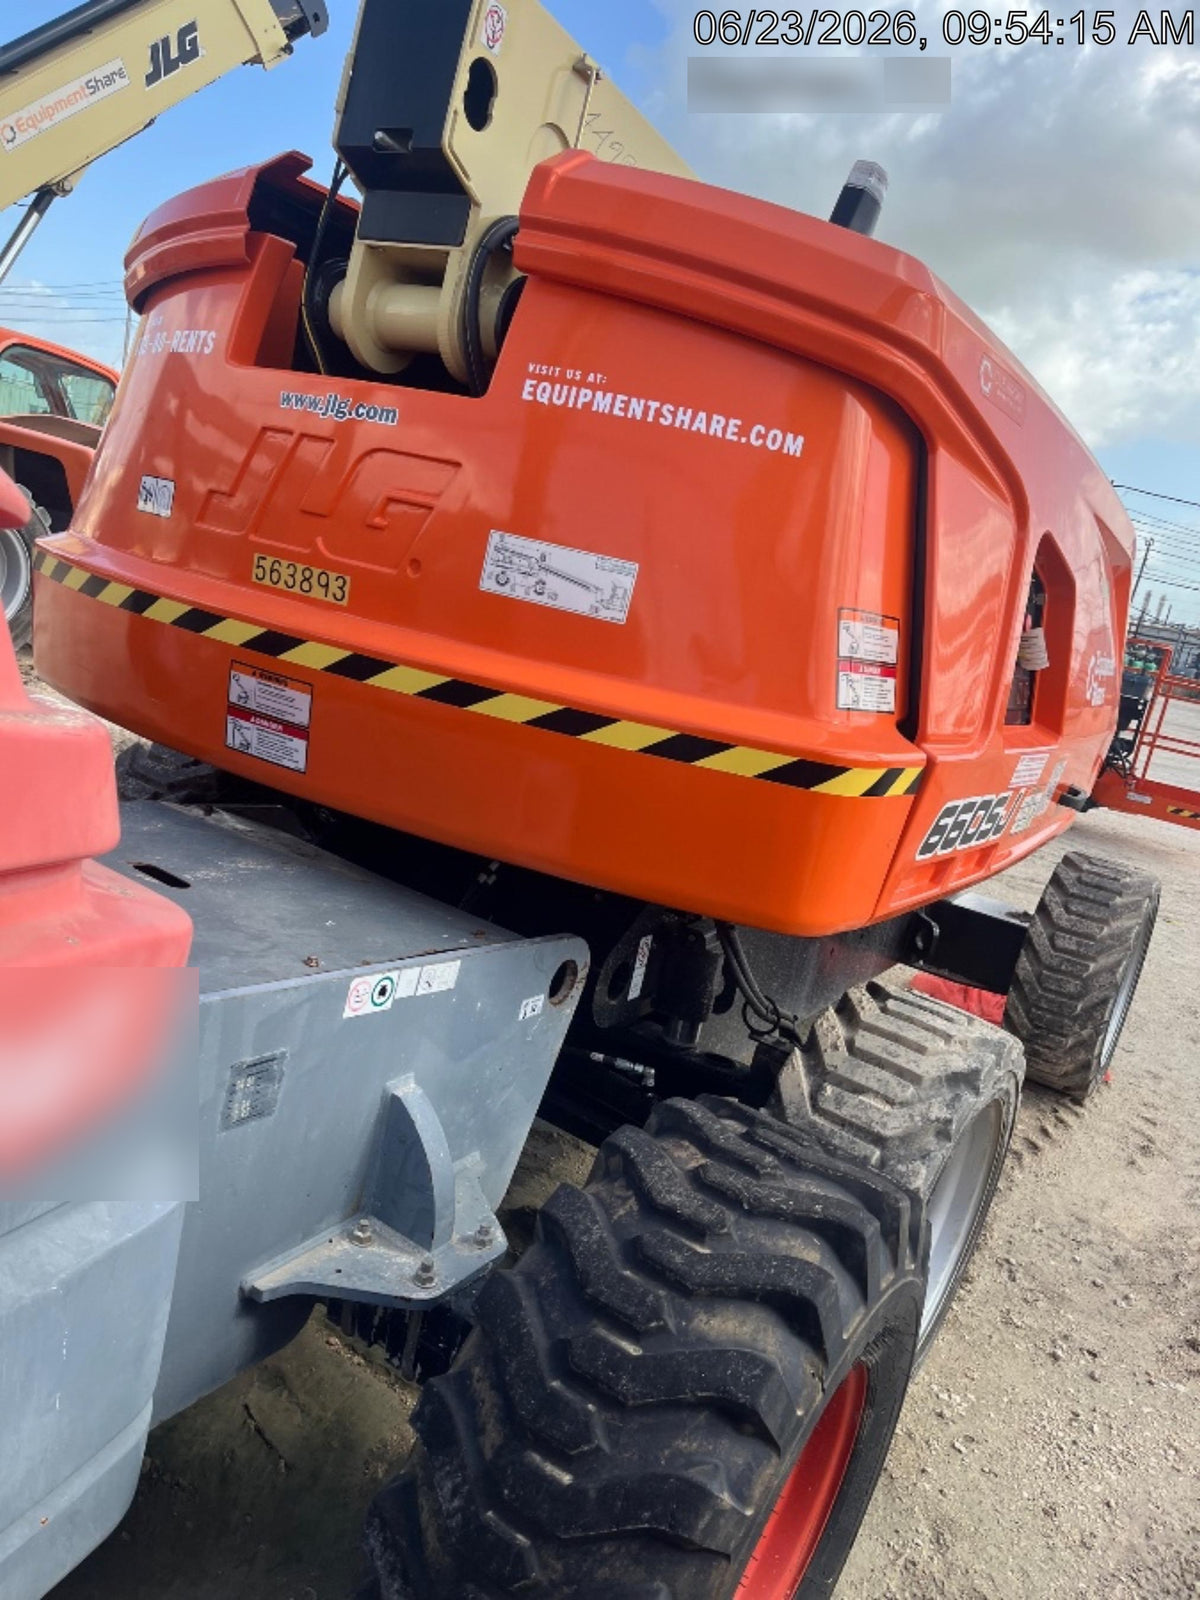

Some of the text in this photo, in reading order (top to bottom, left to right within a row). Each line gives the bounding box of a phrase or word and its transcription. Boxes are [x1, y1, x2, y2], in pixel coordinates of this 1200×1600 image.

[145, 19, 201, 89] JLG
[16, 63, 127, 133] EquipmentShare
[280, 391, 398, 425] www.jlg.com
[528, 362, 608, 384] VISIT US AT:
[521, 378, 805, 458] EQUIPMENTSHARE.COM
[195, 426, 463, 575] JLG
[254, 555, 348, 603] 563893
